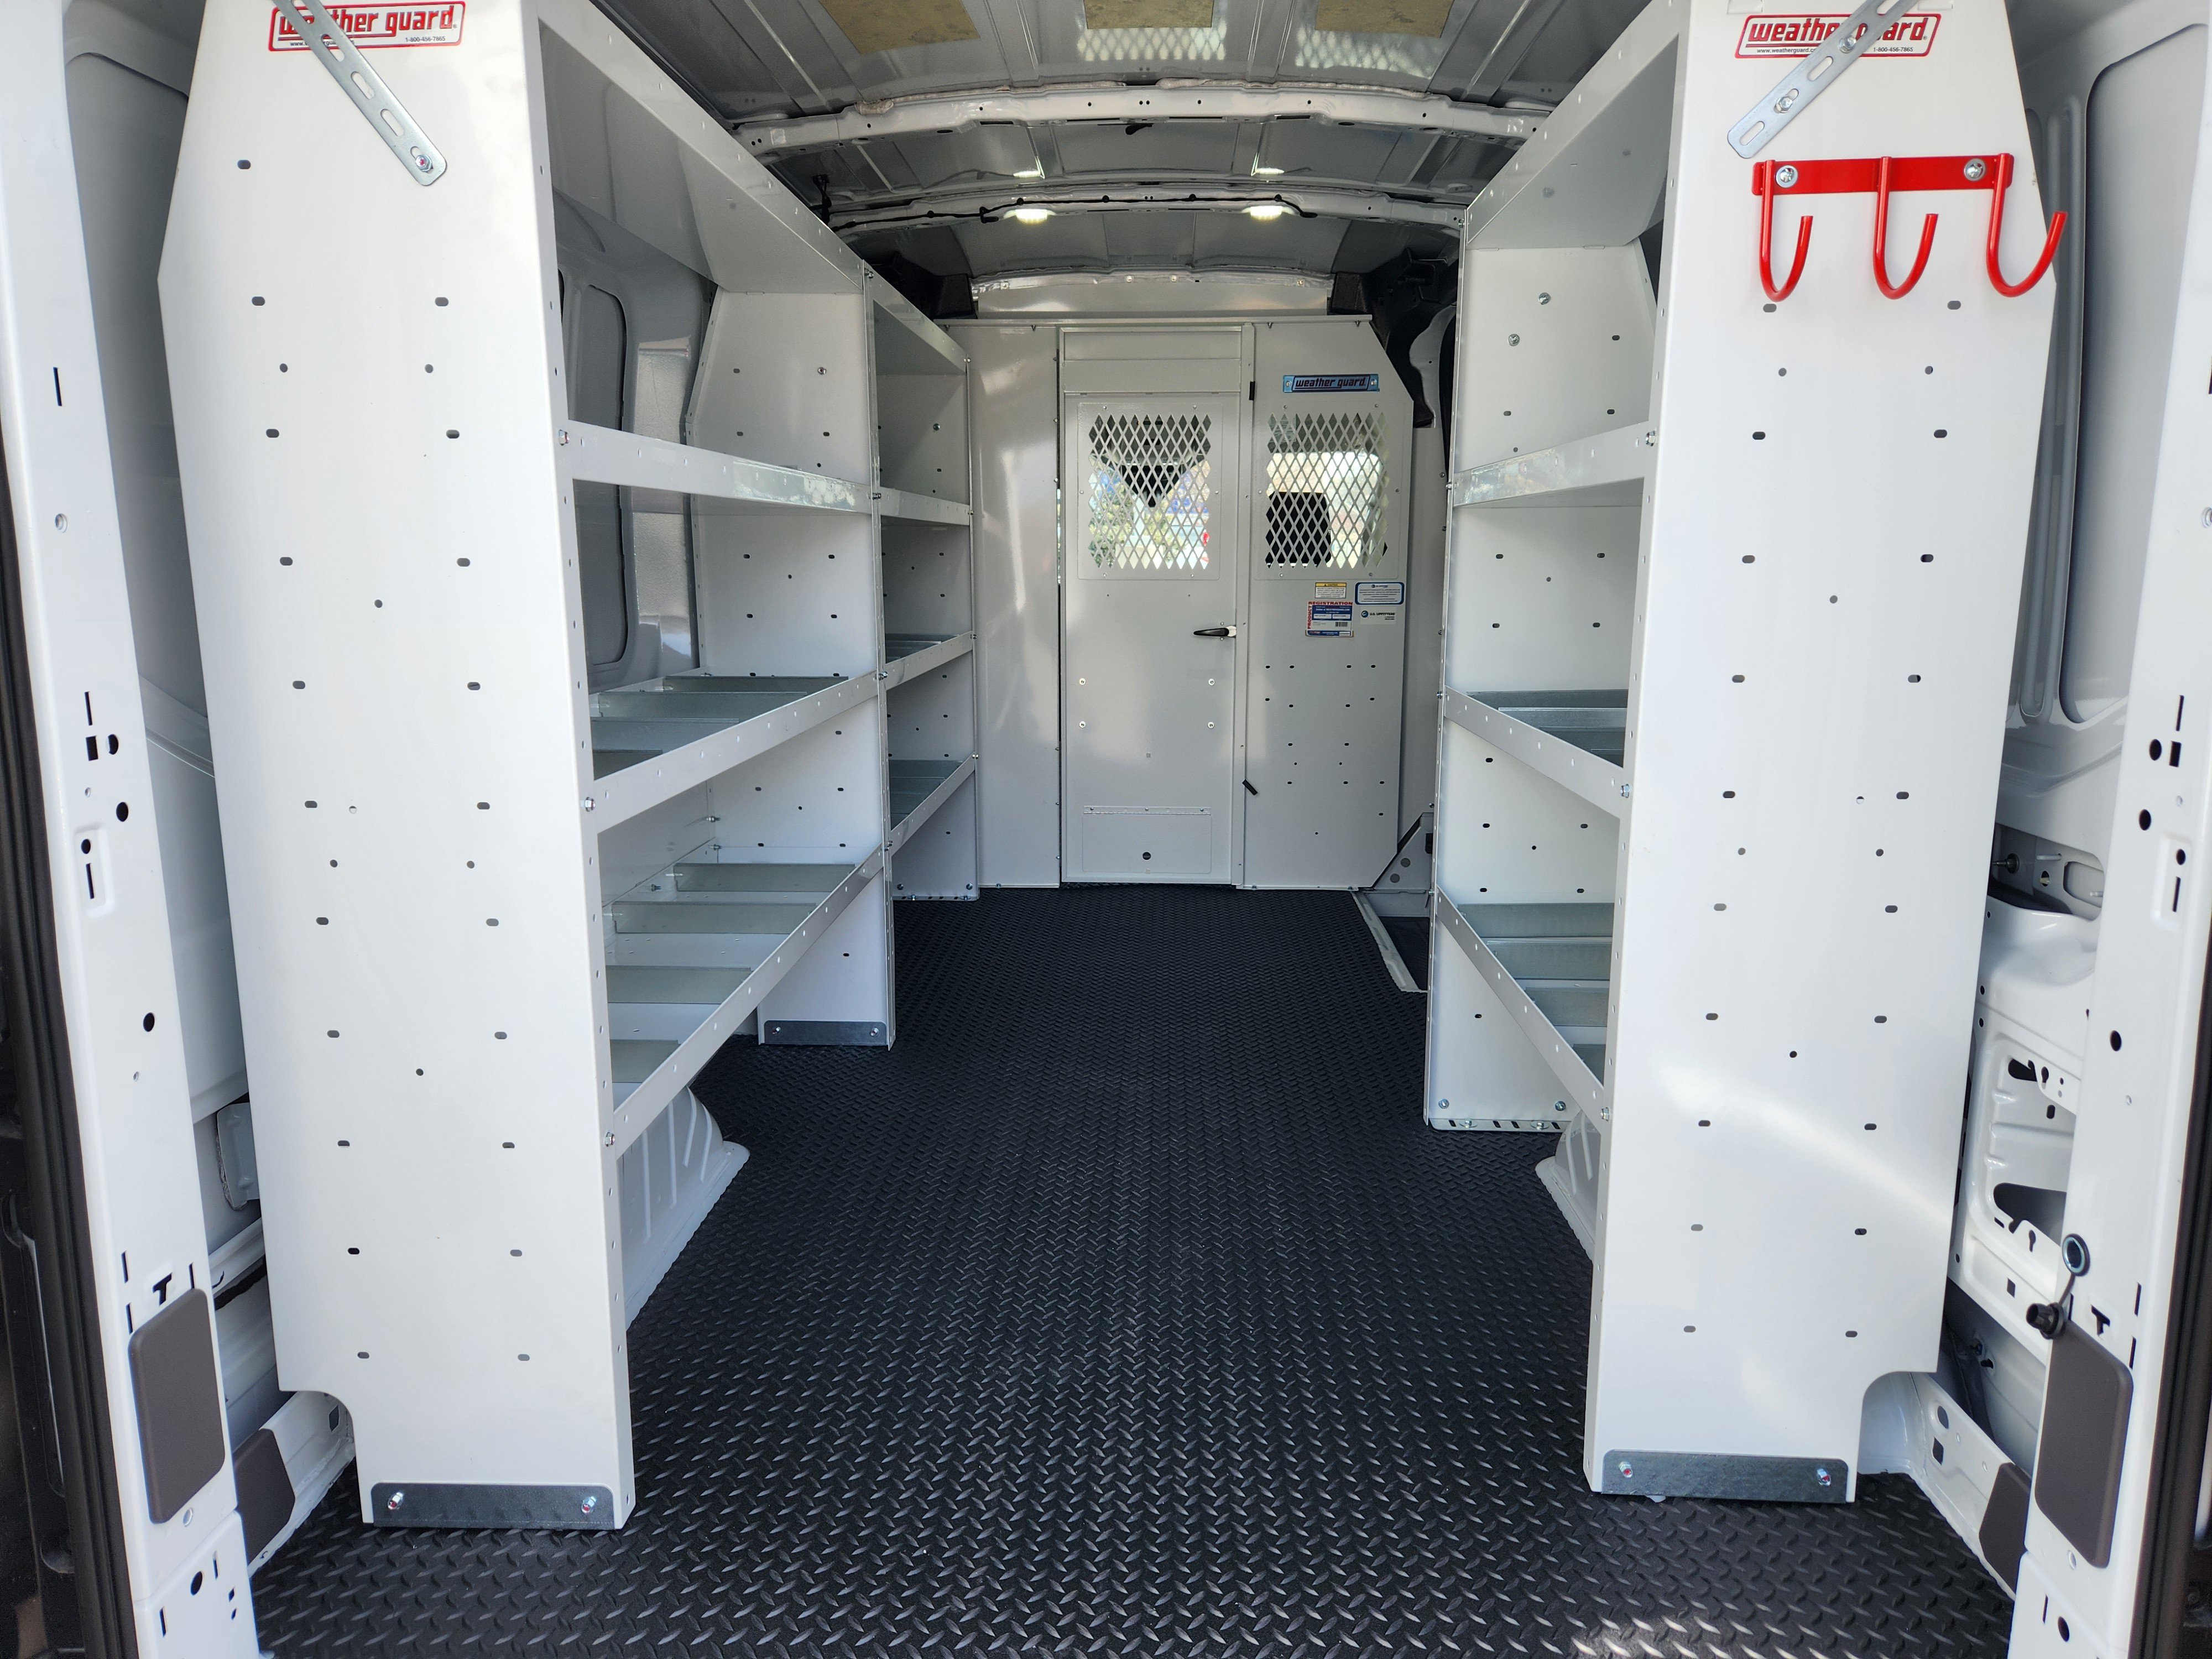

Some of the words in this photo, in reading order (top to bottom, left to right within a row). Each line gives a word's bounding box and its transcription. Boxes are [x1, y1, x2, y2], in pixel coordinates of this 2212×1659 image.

[279, 9, 379, 35] wther
[385, 5, 455, 37] guard
[1748, 18, 1840, 41] weathe
[1855, 18, 1929, 40] ard
[1296, 378, 1335, 387] weather
[1337, 377, 1365, 389] guard
